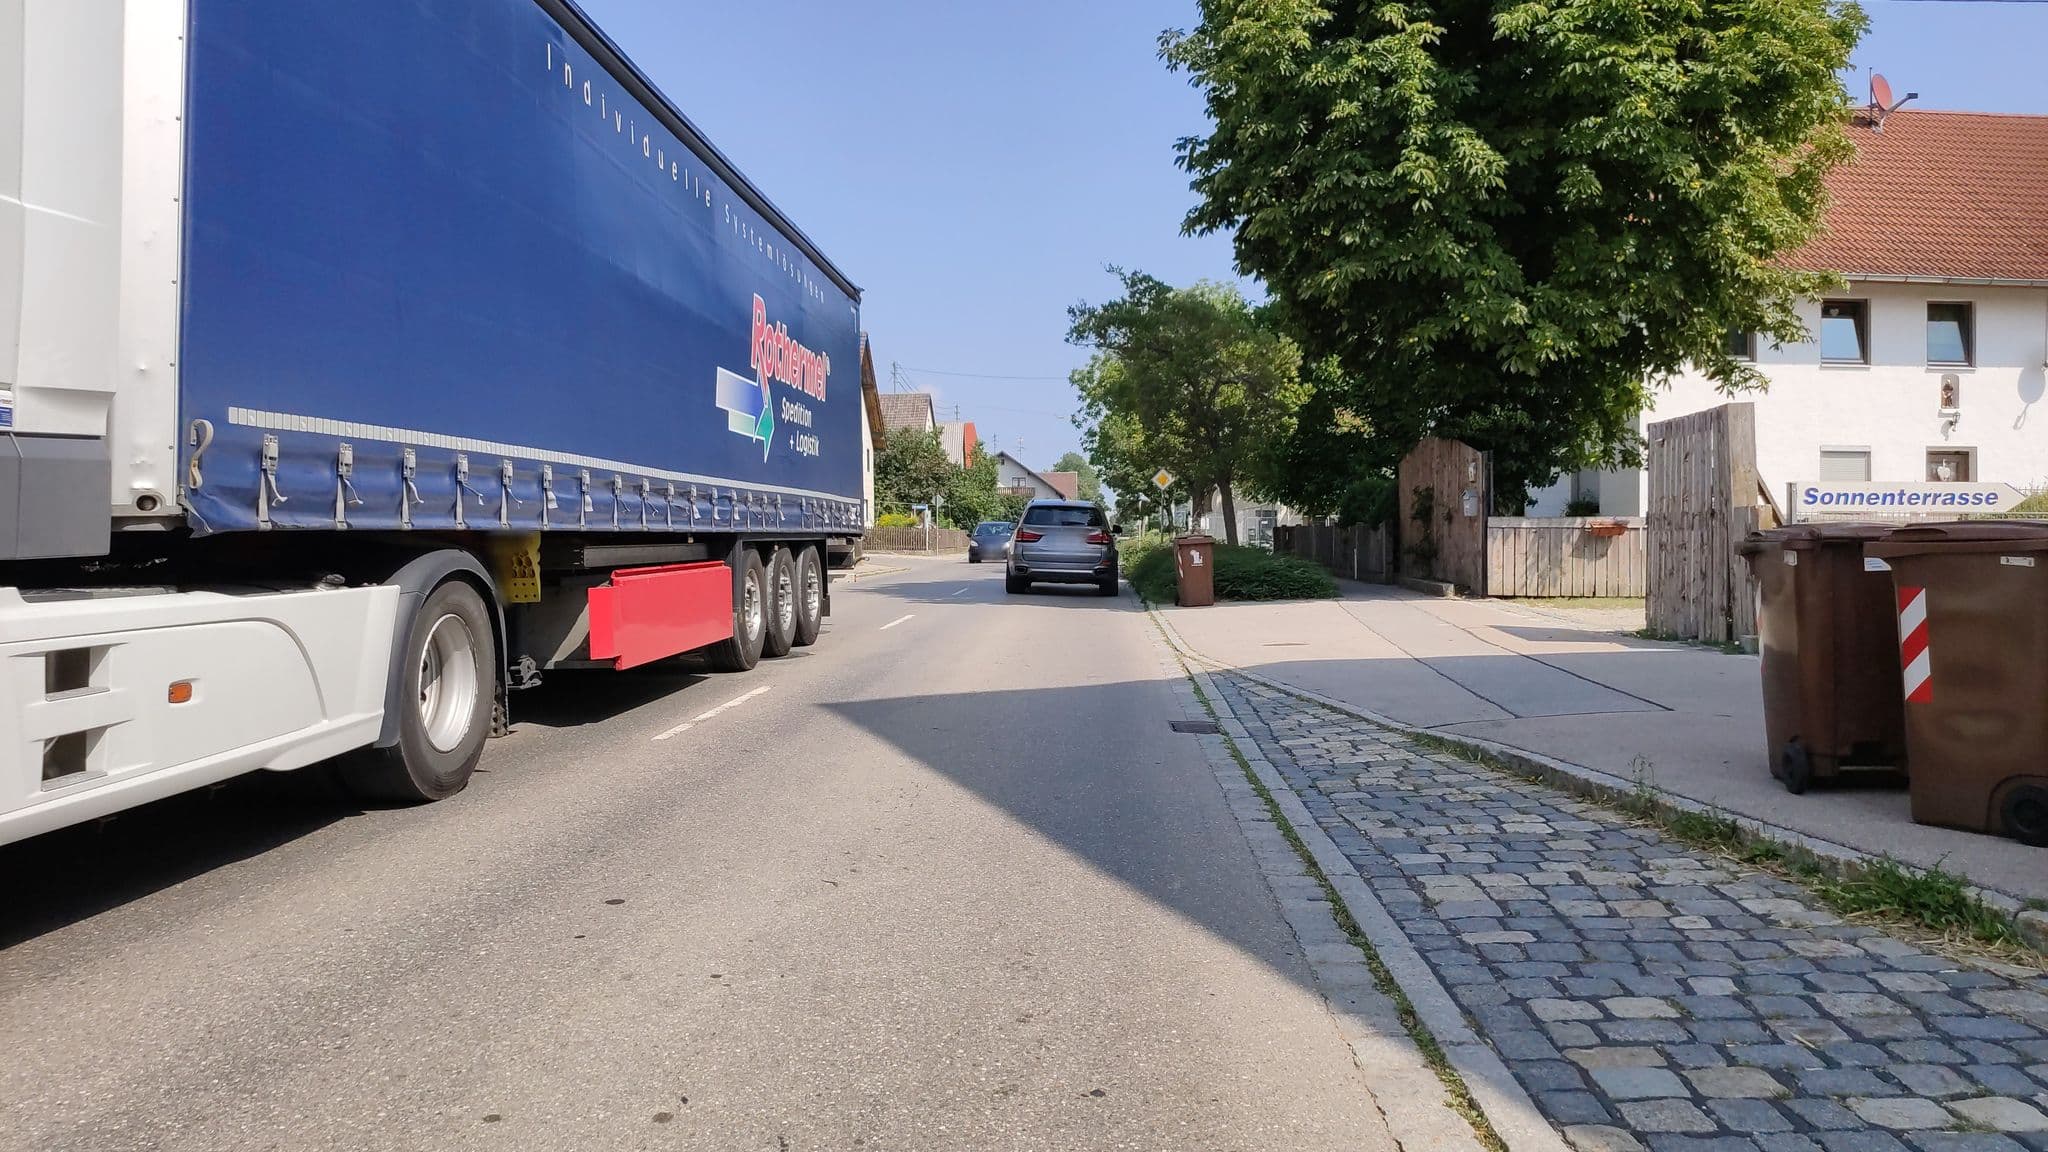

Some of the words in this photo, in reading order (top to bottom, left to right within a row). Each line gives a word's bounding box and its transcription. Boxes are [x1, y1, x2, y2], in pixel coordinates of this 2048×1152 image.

[546, 43, 711, 208] Individuelle
[781, 397, 812, 428] Spedition
[796, 431, 820, 456] Logistik
[1803, 487, 1999, 505] Sonnenterrasse
